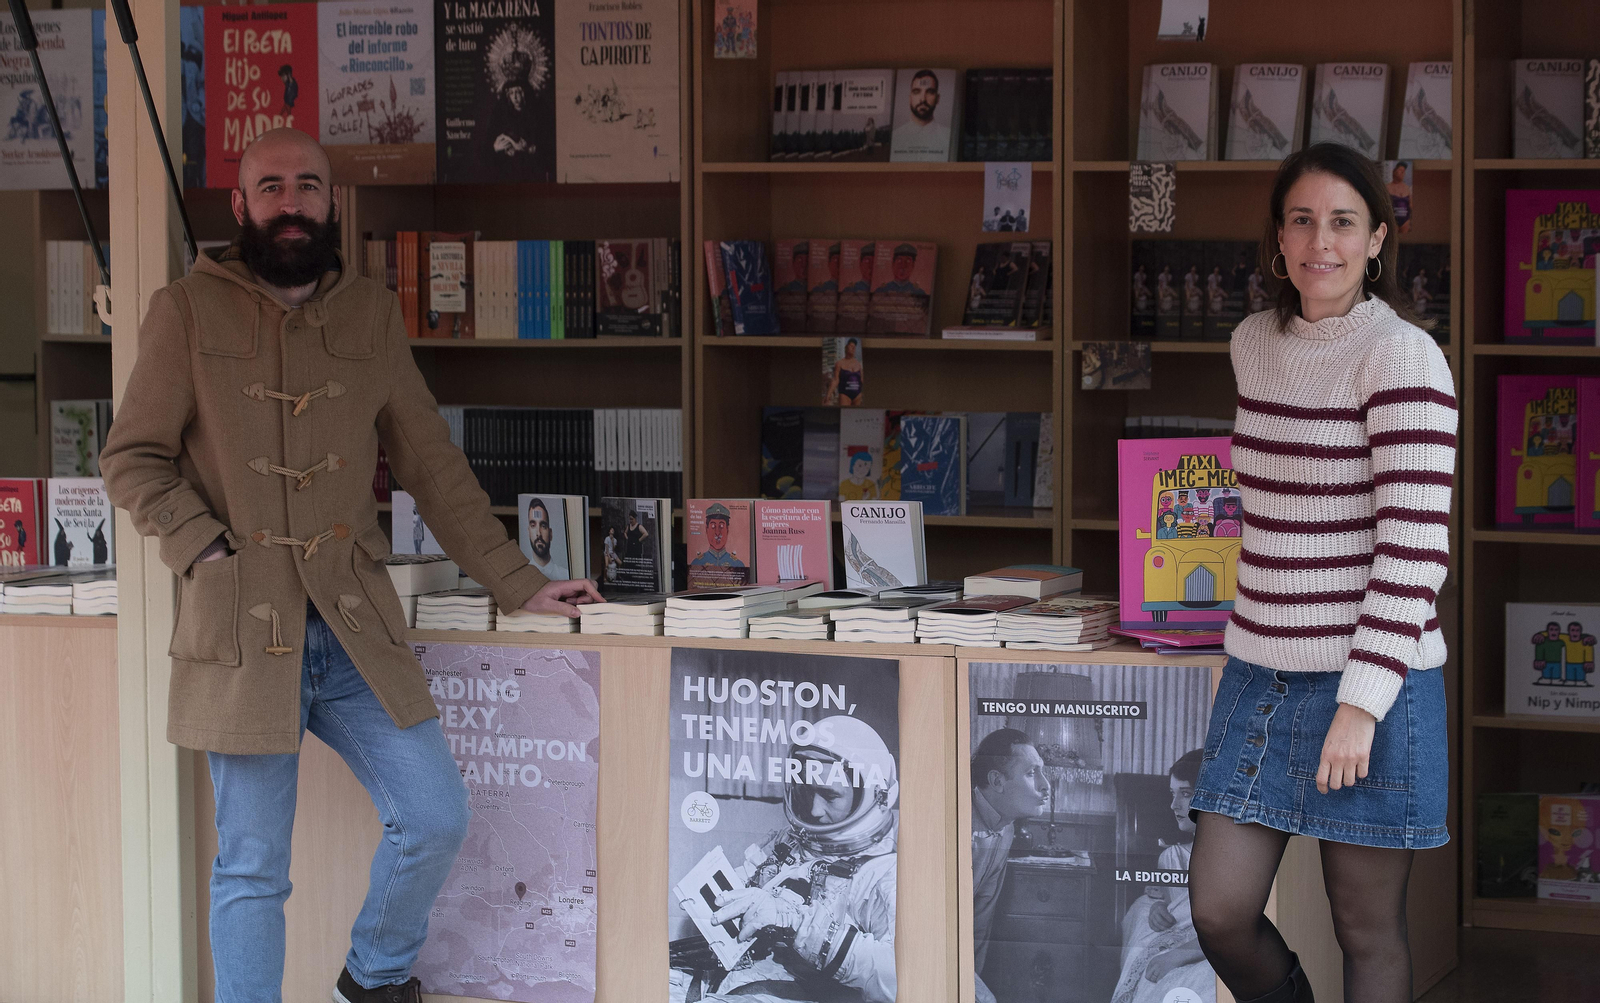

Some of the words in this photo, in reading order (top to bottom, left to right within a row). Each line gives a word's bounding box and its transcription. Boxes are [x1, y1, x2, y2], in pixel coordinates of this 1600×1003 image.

[444, 1, 451, 19] Y
[455, 2, 467, 19] la
[469, 0, 541, 19] MACARENA
[336, 22, 346, 38] El
[349, 20, 393, 35] increíble
[395, 20, 418, 35] robo
[445, 25, 456, 35] se
[458, 22, 484, 34] vistió
[579, 21, 633, 42] TONTOS
[635, 22, 652, 40] DE
[348, 39, 364, 55] del
[368, 38, 407, 54] informe
[445, 38, 457, 52] de
[458, 38, 477, 51] luto
[580, 44, 652, 66] CAPIROTE
[1161, 65, 1208, 77] CANIJO
[1250, 66, 1299, 78] CANIJO
[1333, 65, 1384, 77] CANIJO
[1526, 61, 1582, 74] CANIJO
[227, 90, 248, 111] DE
[252, 86, 271, 111] SU
[331, 108, 338, 119] A
[342, 105, 354, 118] LA
[1559, 202, 1587, 214] TAXI
[1181, 455, 1216, 469] TAXI
[58, 485, 70, 495] Los
[55, 496, 86, 506] modernos
[87, 496, 96, 506] de
[97, 496, 104, 506] la
[57, 506, 82, 517] Semana
[83, 507, 102, 517] Santa
[761, 506, 781, 514] Cómo
[782, 506, 806, 514] acabar
[850, 506, 906, 519] CANIJO
[64, 518, 72, 528] de
[762, 521, 790, 530] mujeres
[425, 669, 462, 677] Manchester
[683, 676, 857, 715] HUOSTON,
[983, 702, 1027, 714] TENGO
[1030, 703, 1050, 714] UN
[1054, 704, 1140, 717] MANUSCRITO
[1528, 696, 1551, 709] Nip
[1554, 699, 1561, 710] y
[681, 714, 836, 747] TENEMOS
[683, 752, 756, 781] UNA
[768, 757, 888, 789] ERRATA
[1115, 870, 1131, 881] LA
[461, 884, 485, 892] Swindon
[558, 896, 584, 904] Londres
